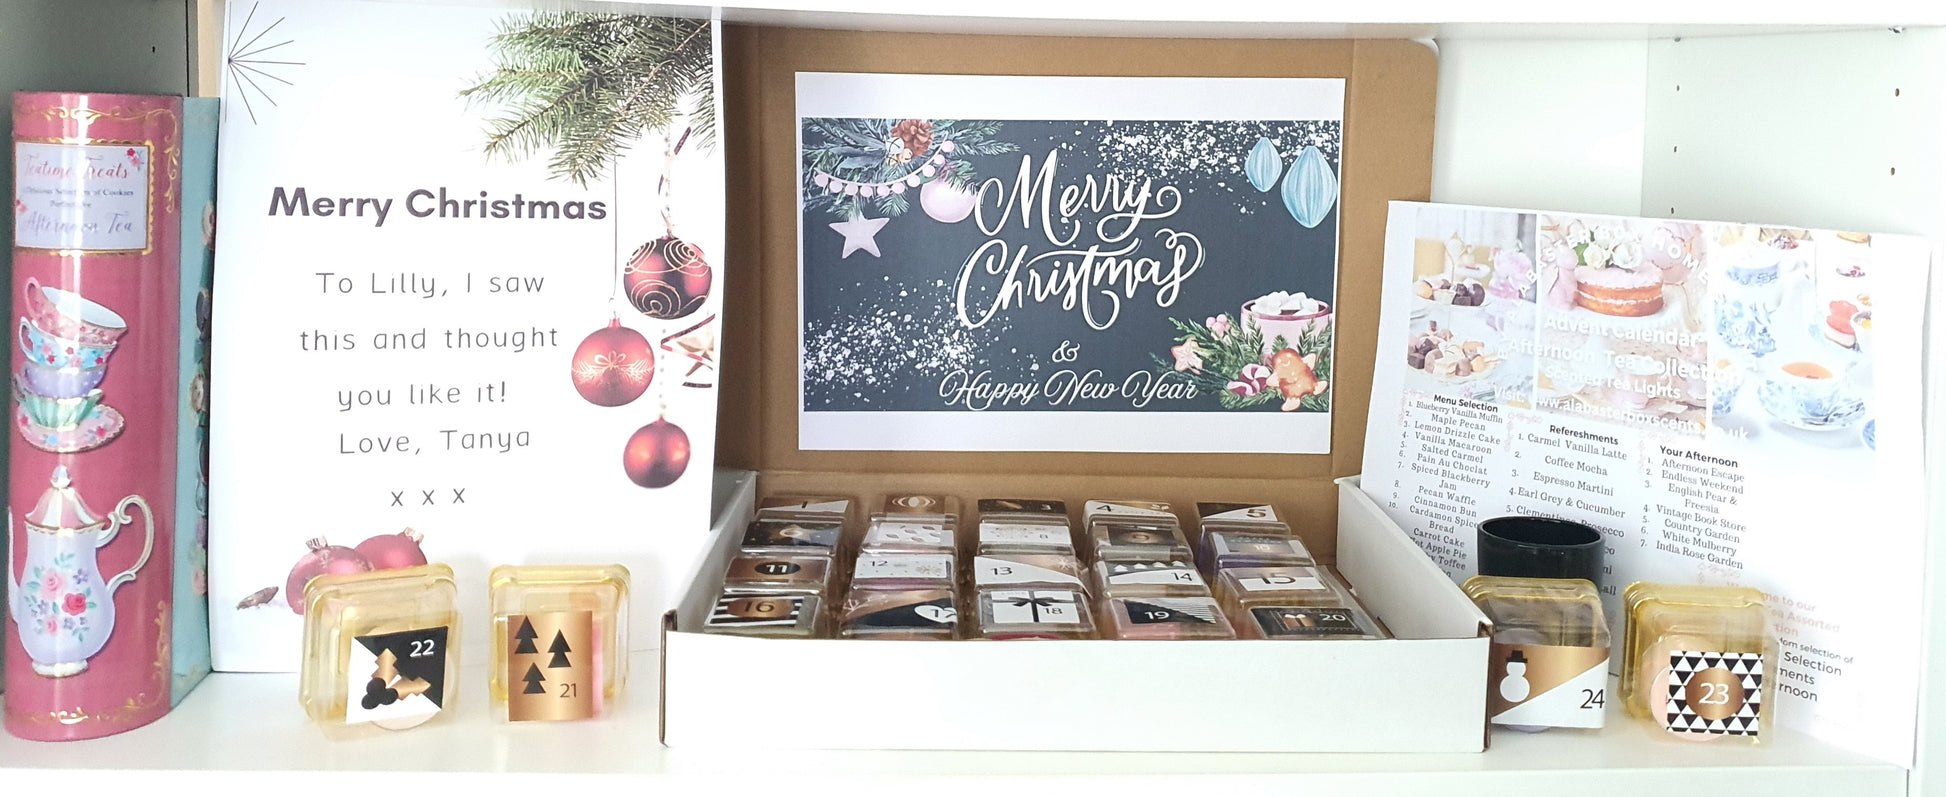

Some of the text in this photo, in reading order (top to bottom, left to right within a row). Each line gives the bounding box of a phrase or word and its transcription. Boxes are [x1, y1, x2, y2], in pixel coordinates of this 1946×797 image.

[268, 187, 607, 227] Merry Christmas
[974, 149, 1182, 246] Merry
[106, 212, 134, 234] Tea
[315, 272, 545, 299] To Lilly, I saw
[954, 228, 1205, 330] Christmas
[1544, 315, 1609, 336] Advent
[300, 327, 558, 352] this and thought
[1052, 340, 1080, 362] &
[1511, 337, 1596, 360] Afternoon
[1604, 350, 1633, 370] Tea
[1636, 354, 1741, 384] Collecton
[338, 381, 506, 412] you like it!
[939, 369, 1198, 410] Happy New Year
[1606, 377, 1632, 390] Tea
[1634, 379, 1682, 399] Lights
[1416, 401, 1450, 414] Blueberry
[1452, 406, 1477, 419] Vanilla
[1478, 412, 1503, 424] Muffin
[1433, 394, 1498, 413] Menu Selection
[1414, 420, 1442, 434] Lemon
[1444, 426, 1476, 440] Drizzle
[1478, 433, 1501, 445] Cake
[1431, 414, 1457, 426] Maple
[1459, 418, 1486, 431] Pecan
[340, 430, 530, 456] Love, Tanya
[1415, 432, 1446, 444] Vanilla
[1448, 440, 1492, 454] Macaroon
[1549, 424, 1619, 445] Refereshments
[1421, 444, 1449, 456] Salted
[1452, 450, 1484, 464] Carmel
[1527, 433, 1560, 448] Carmel
[1565, 440, 1600, 455] Vanilla
[1602, 447, 1628, 461] Latte
[1660, 445, 1739, 468] Your Afternoon
[1411, 462, 1439, 476] Spiced
[1441, 469, 1491, 488] Blackberry
[1418, 453, 1436, 464] Pain
[1438, 458, 1450, 468] Au
[1452, 460, 1488, 475] Choclat
[1544, 455, 1574, 469] Coffee
[1576, 461, 1608, 476] Mocha
[1662, 458, 1708, 476] Afternoon
[1711, 468, 1745, 483] Escape
[1439, 480, 1457, 491] Jam
[1533, 471, 1576, 488] Espresso
[1577, 480, 1614, 496] Martini
[1662, 469, 1698, 485] Endless
[1700, 477, 1744, 494] Weekend
[391, 488, 466, 507] x x x
[1419, 486, 1444, 498] Pecan
[1446, 492, 1476, 506] Waffle
[1518, 487, 1538, 499] Earl
[1540, 492, 1564, 506] Grey
[1566, 497, 1574, 507] &
[1576, 499, 1626, 518] Cucumber
[1668, 482, 1704, 498] English
[1705, 490, 1727, 504] Pear
[1730, 496, 1738, 506] &
[1096, 504, 1112, 512] 4
[1246, 508, 1266, 518] 5
[1410, 505, 1452, 523] Cardamon
[1414, 496, 1457, 512] Cinnamon
[1460, 506, 1477, 518] Bun
[1684, 498, 1720, 514] Freesia
[1429, 521, 1454, 534] Bread
[1656, 504, 1692, 522] Vintage
[1694, 512, 1718, 526] Book
[1720, 518, 1747, 533] Store
[1414, 528, 1465, 548] Carrot Cake
[1664, 518, 1702, 537] Country
[1704, 527, 1740, 544] Garden
[1426, 542, 1467, 560] Apple Pie
[1662, 529, 1691, 544] White
[1692, 536, 1737, 557] Mulberry
[1438, 556, 1466, 570] Toffee
[1656, 540, 1680, 554] India
[1682, 546, 1706, 560] Rose
[1707, 552, 1744, 570] Garden
[766, 564, 788, 573] 11
[990, 566, 1013, 576] 13
[1170, 572, 1193, 582] 14
[745, 601, 775, 613] 16
[1044, 608, 1063, 616] 18
[1144, 610, 1170, 620] 19
[1782, 596, 1794, 607] to
[1796, 601, 1816, 612] our
[1320, 614, 1346, 622] 20
[1787, 611, 1841, 633] Assorted
[409, 638, 435, 658] 22
[1800, 643, 1842, 661] selection
[1784, 651, 1842, 676] Selection
[559, 682, 578, 698] 21
[1580, 688, 1605, 709] 24
[1698, 682, 1730, 706] 23
